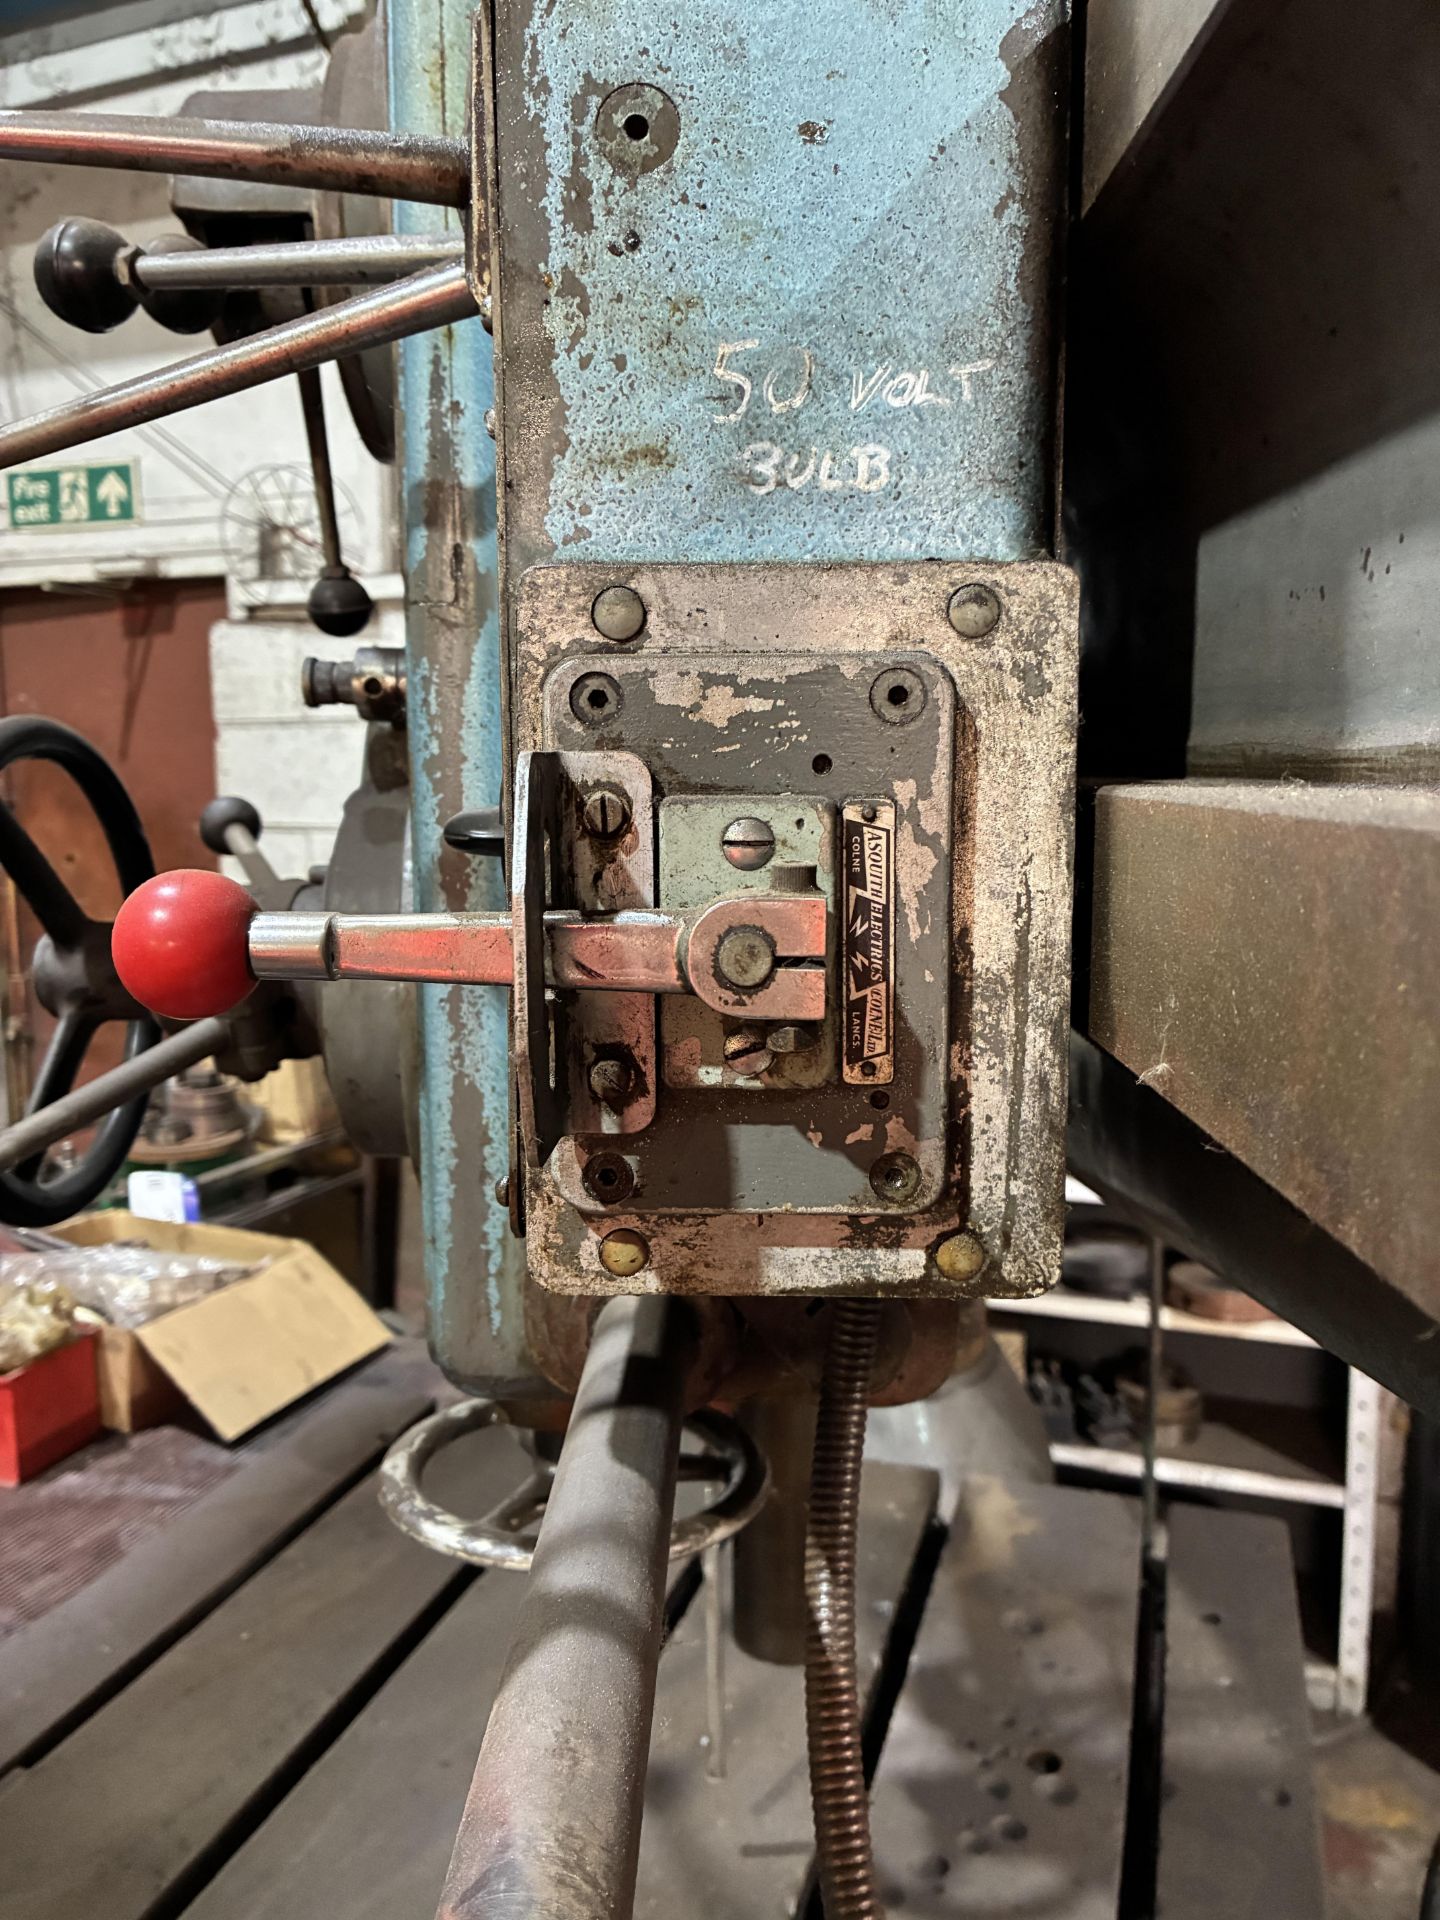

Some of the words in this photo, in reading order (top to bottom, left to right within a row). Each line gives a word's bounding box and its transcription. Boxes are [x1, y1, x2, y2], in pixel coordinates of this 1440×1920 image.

[711, 338, 814, 423] 50
[850, 359, 996, 412] VOLT
[851, 835, 861, 873] COLNE
[866, 830, 883, 899] ASQUITH
[870, 901, 883, 982] ELECTRICS
[852, 1011, 861, 1049] LANCS.
